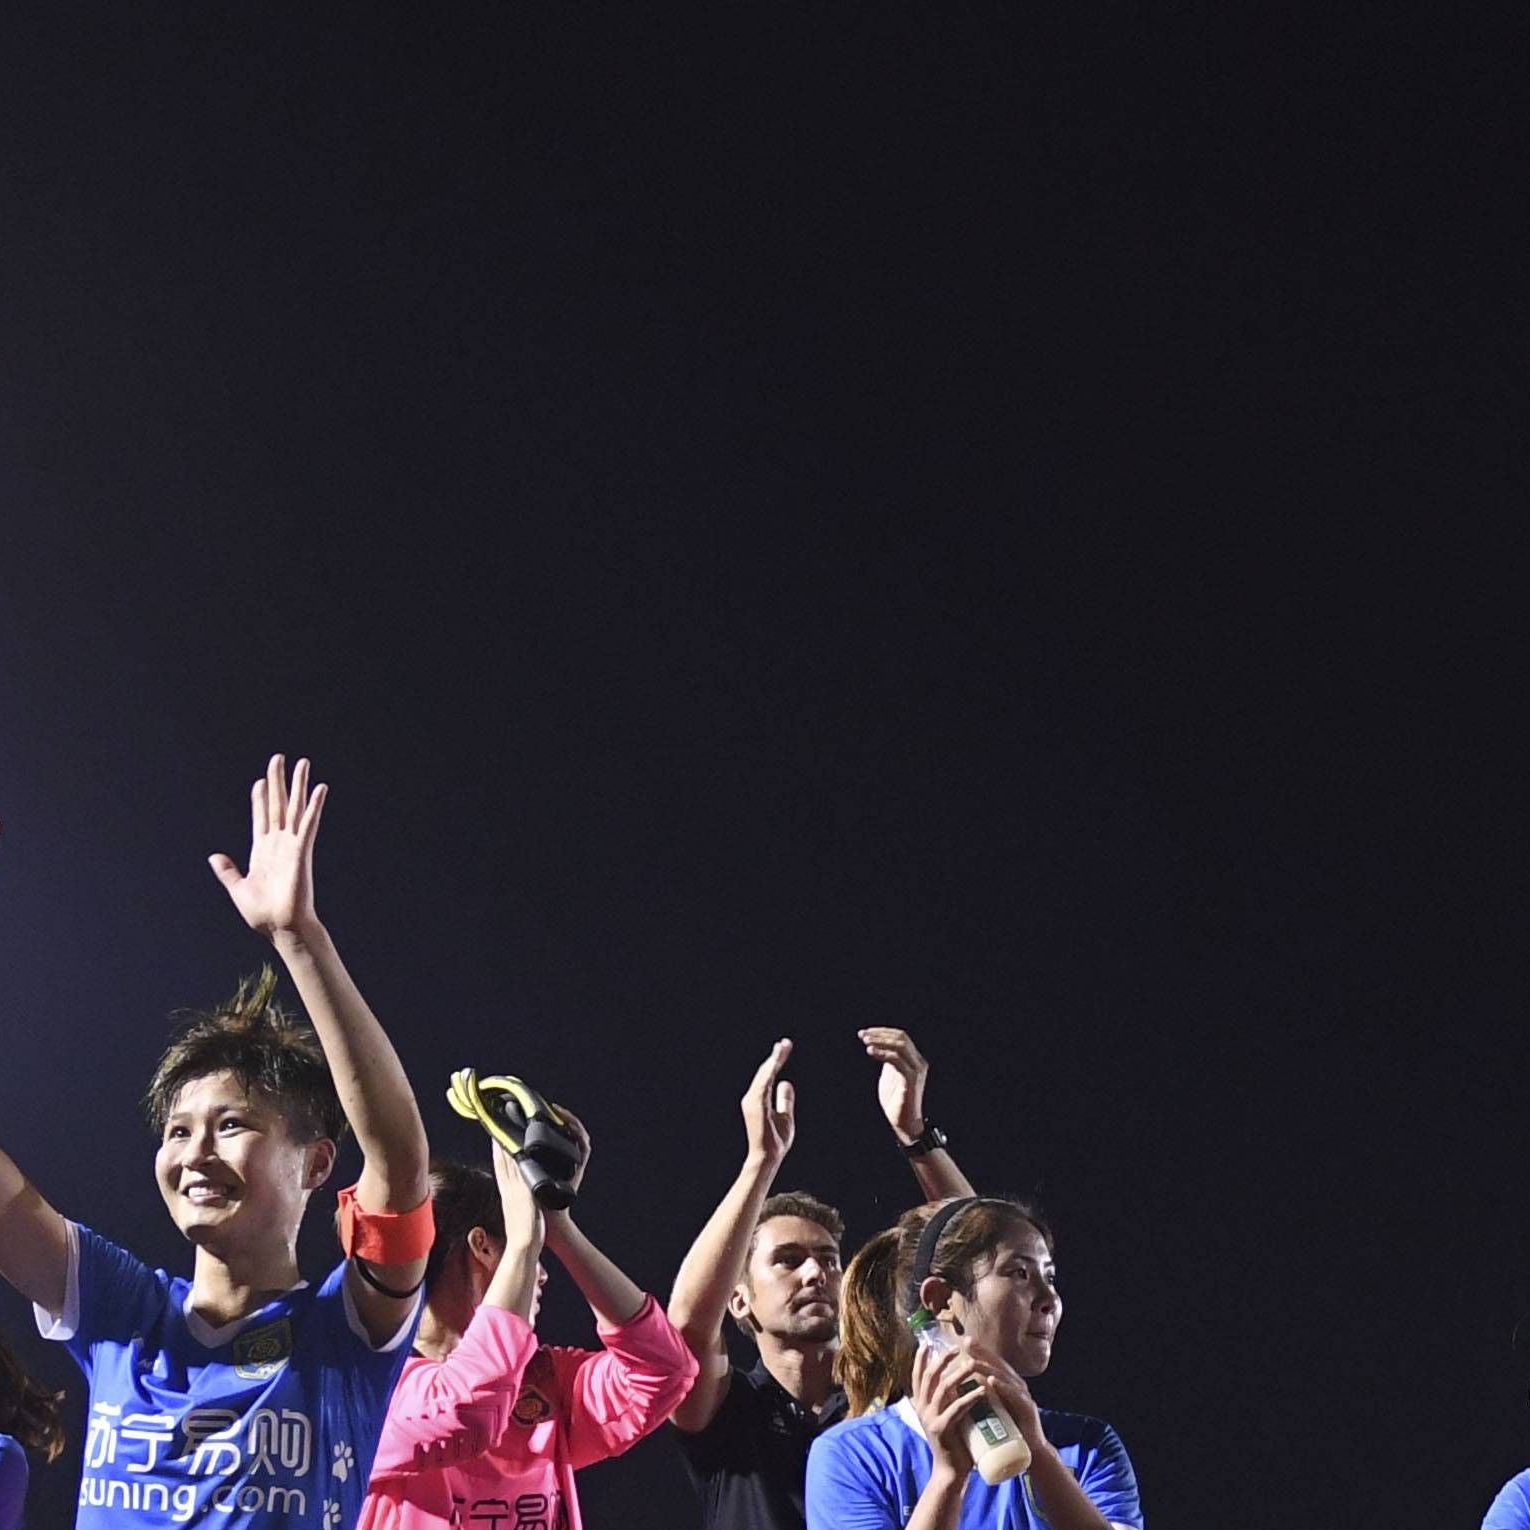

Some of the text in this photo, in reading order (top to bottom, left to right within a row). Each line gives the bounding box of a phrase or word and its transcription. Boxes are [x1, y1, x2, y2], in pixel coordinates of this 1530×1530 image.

[85, 1401, 312, 1477] 苏宁易购
[79, 1477, 306, 1522] suning.com
